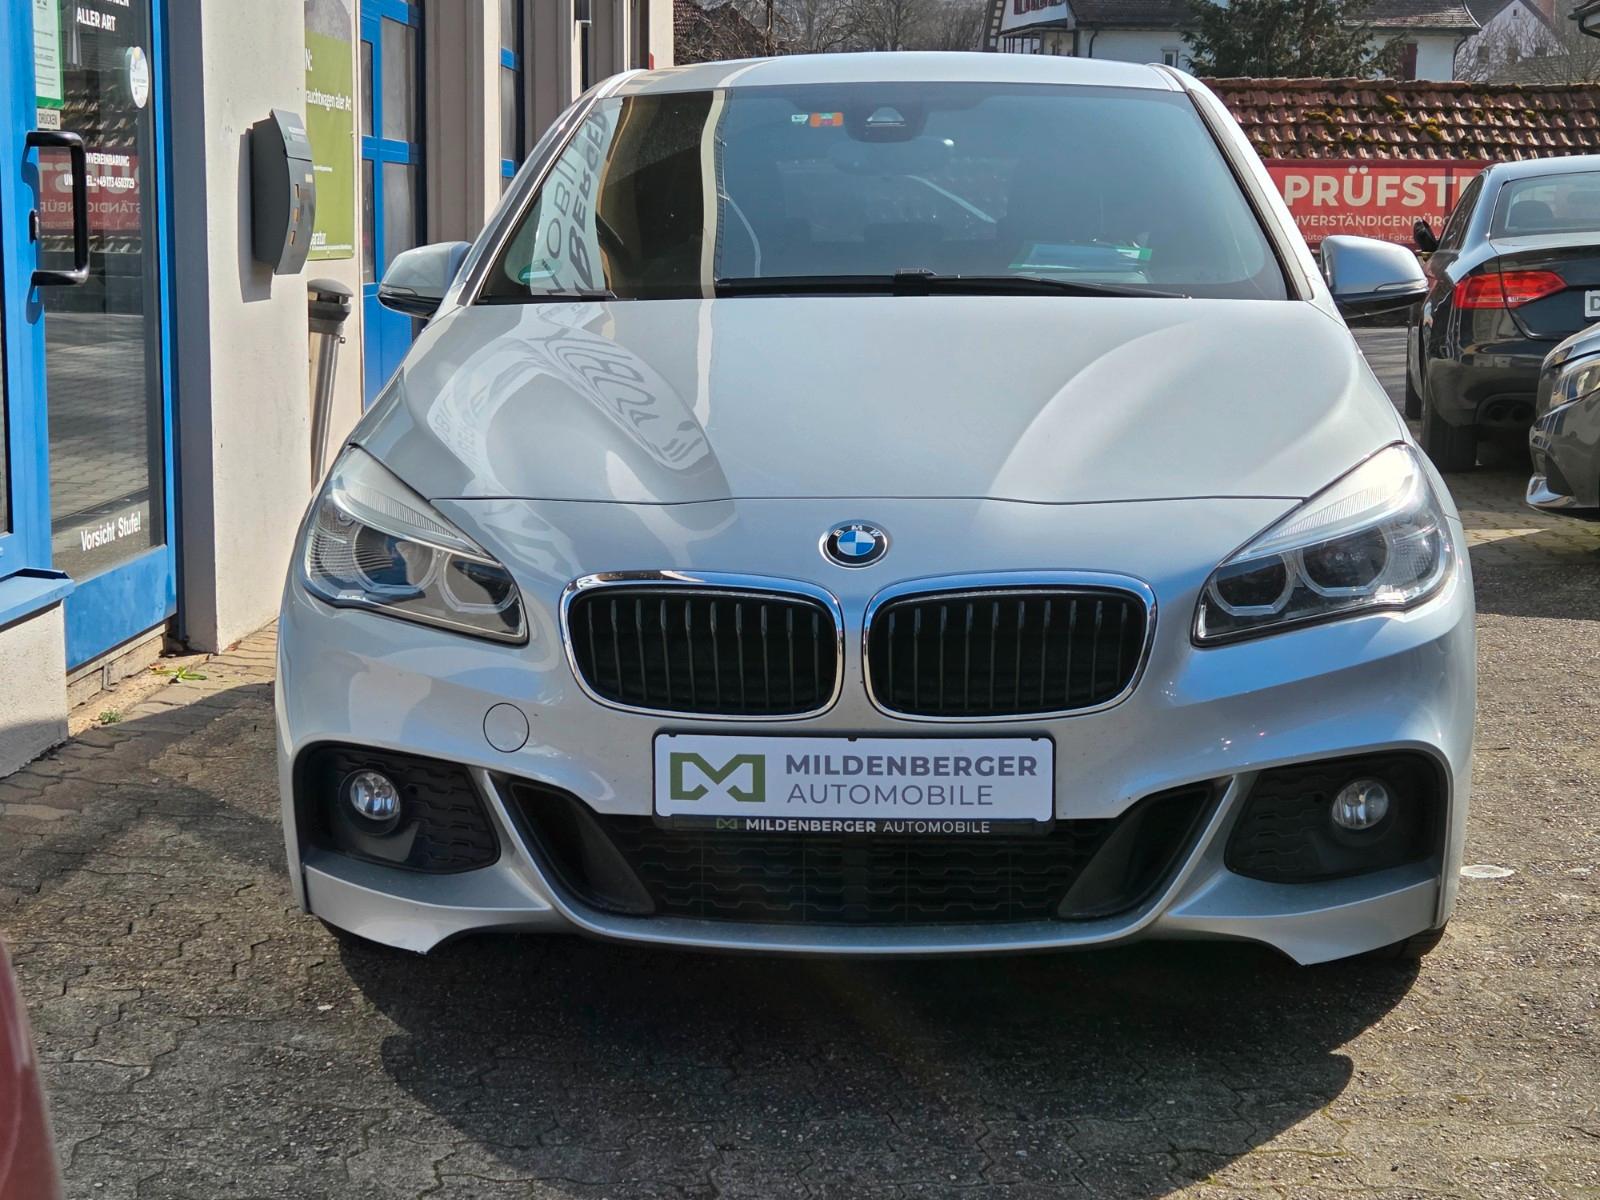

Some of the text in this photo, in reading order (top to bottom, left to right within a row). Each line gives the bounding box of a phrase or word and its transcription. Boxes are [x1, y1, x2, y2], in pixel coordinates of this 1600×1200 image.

[76, 7, 117, 32] ALLER ART
[63, 173, 74, 186] UN
[85, 175, 97, 187] EL.:
[81, 511, 141, 552] Vorsicht Stufe!
[833, 524, 881, 537] BMW
[786, 754, 1037, 777] MILDENBERGER
[787, 783, 993, 806] AUTOMOBILE
[746, 818, 990, 833] MILDENBERGER AUTOMOBILE
